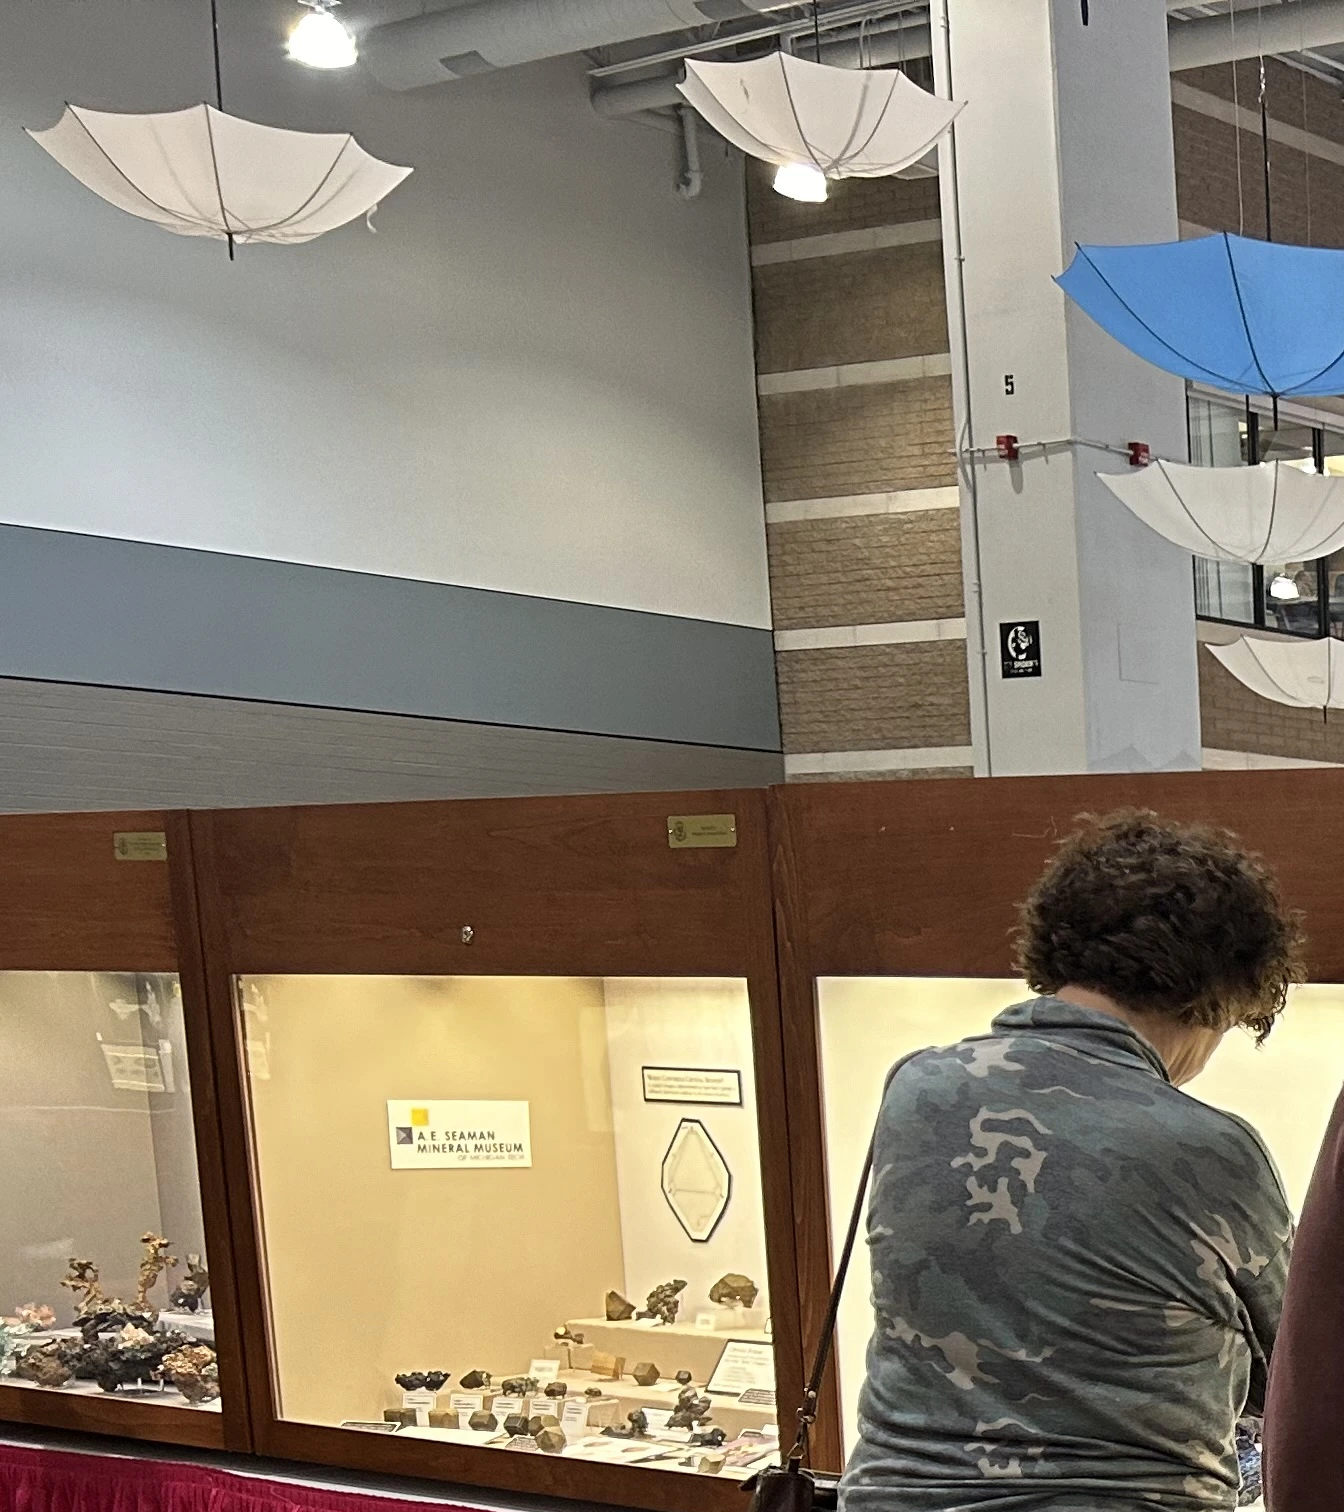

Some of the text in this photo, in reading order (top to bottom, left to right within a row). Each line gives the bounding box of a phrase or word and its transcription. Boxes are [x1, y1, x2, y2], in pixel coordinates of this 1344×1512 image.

[1004, 374, 1015, 395] 5
[445, 1131, 495, 1141] SEAMAN
[417, 1143, 524, 1154] MINERAL MUSEUM
